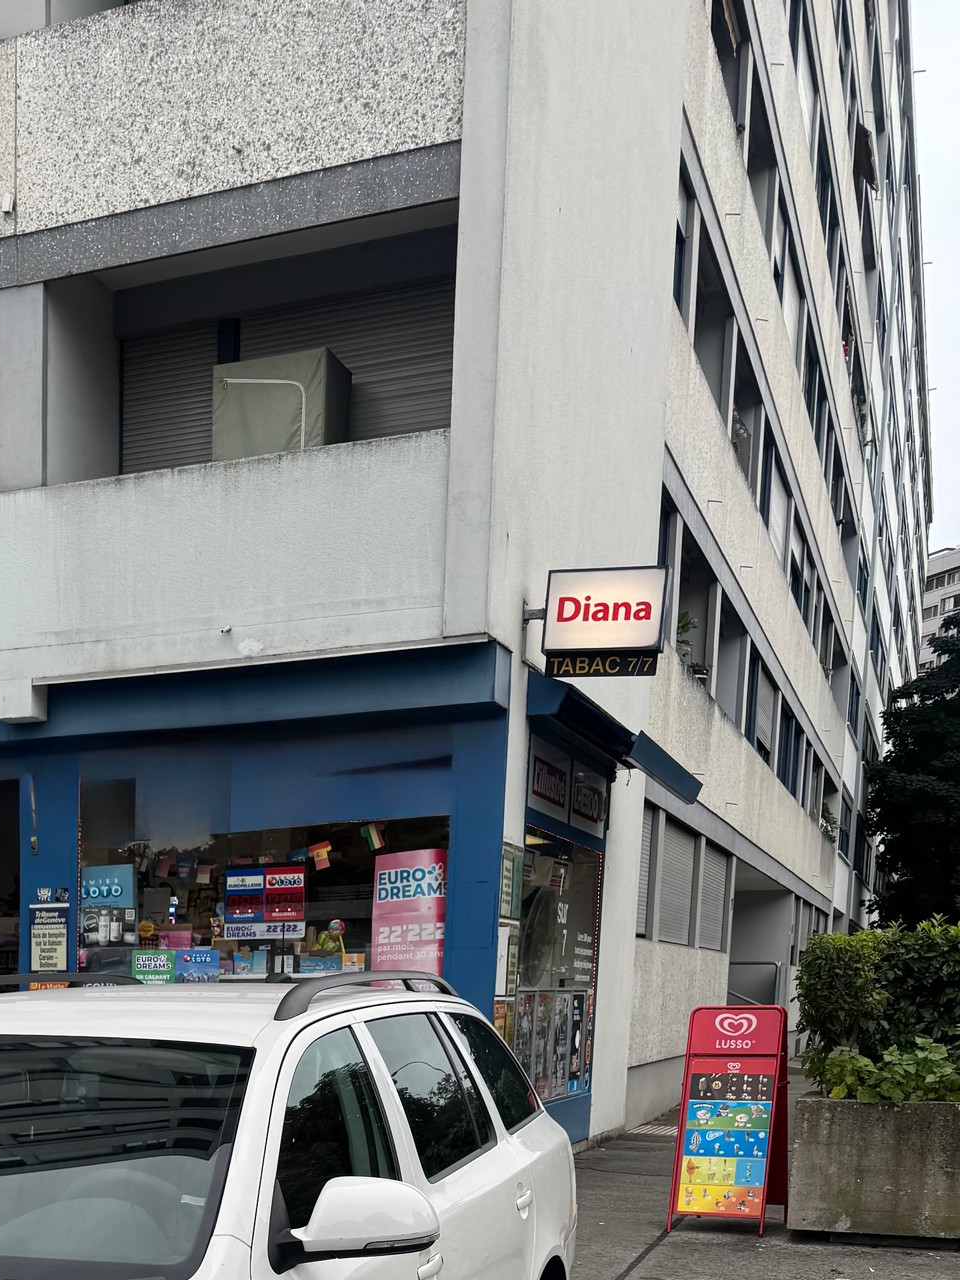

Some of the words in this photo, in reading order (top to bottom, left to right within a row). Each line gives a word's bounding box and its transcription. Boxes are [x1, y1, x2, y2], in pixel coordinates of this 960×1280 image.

[556, 595, 652, 622] Diana
[550, 656, 620, 674] TABAC
[627, 656, 653, 676] 7/7
[82, 878, 119, 886] SWISS
[378, 866, 427, 887] EURO
[81, 886, 123, 899] LOTO
[557, 902, 569, 924] sur
[377, 945, 390, 954] par
[392, 942, 415, 950] mois
[136, 955, 159, 963] EURO
[377, 952, 414, 963] pendant
[415, 950, 427, 959] 30
[136, 962, 171, 970] DREAMS
[715, 1040, 752, 1049] LUSSO
